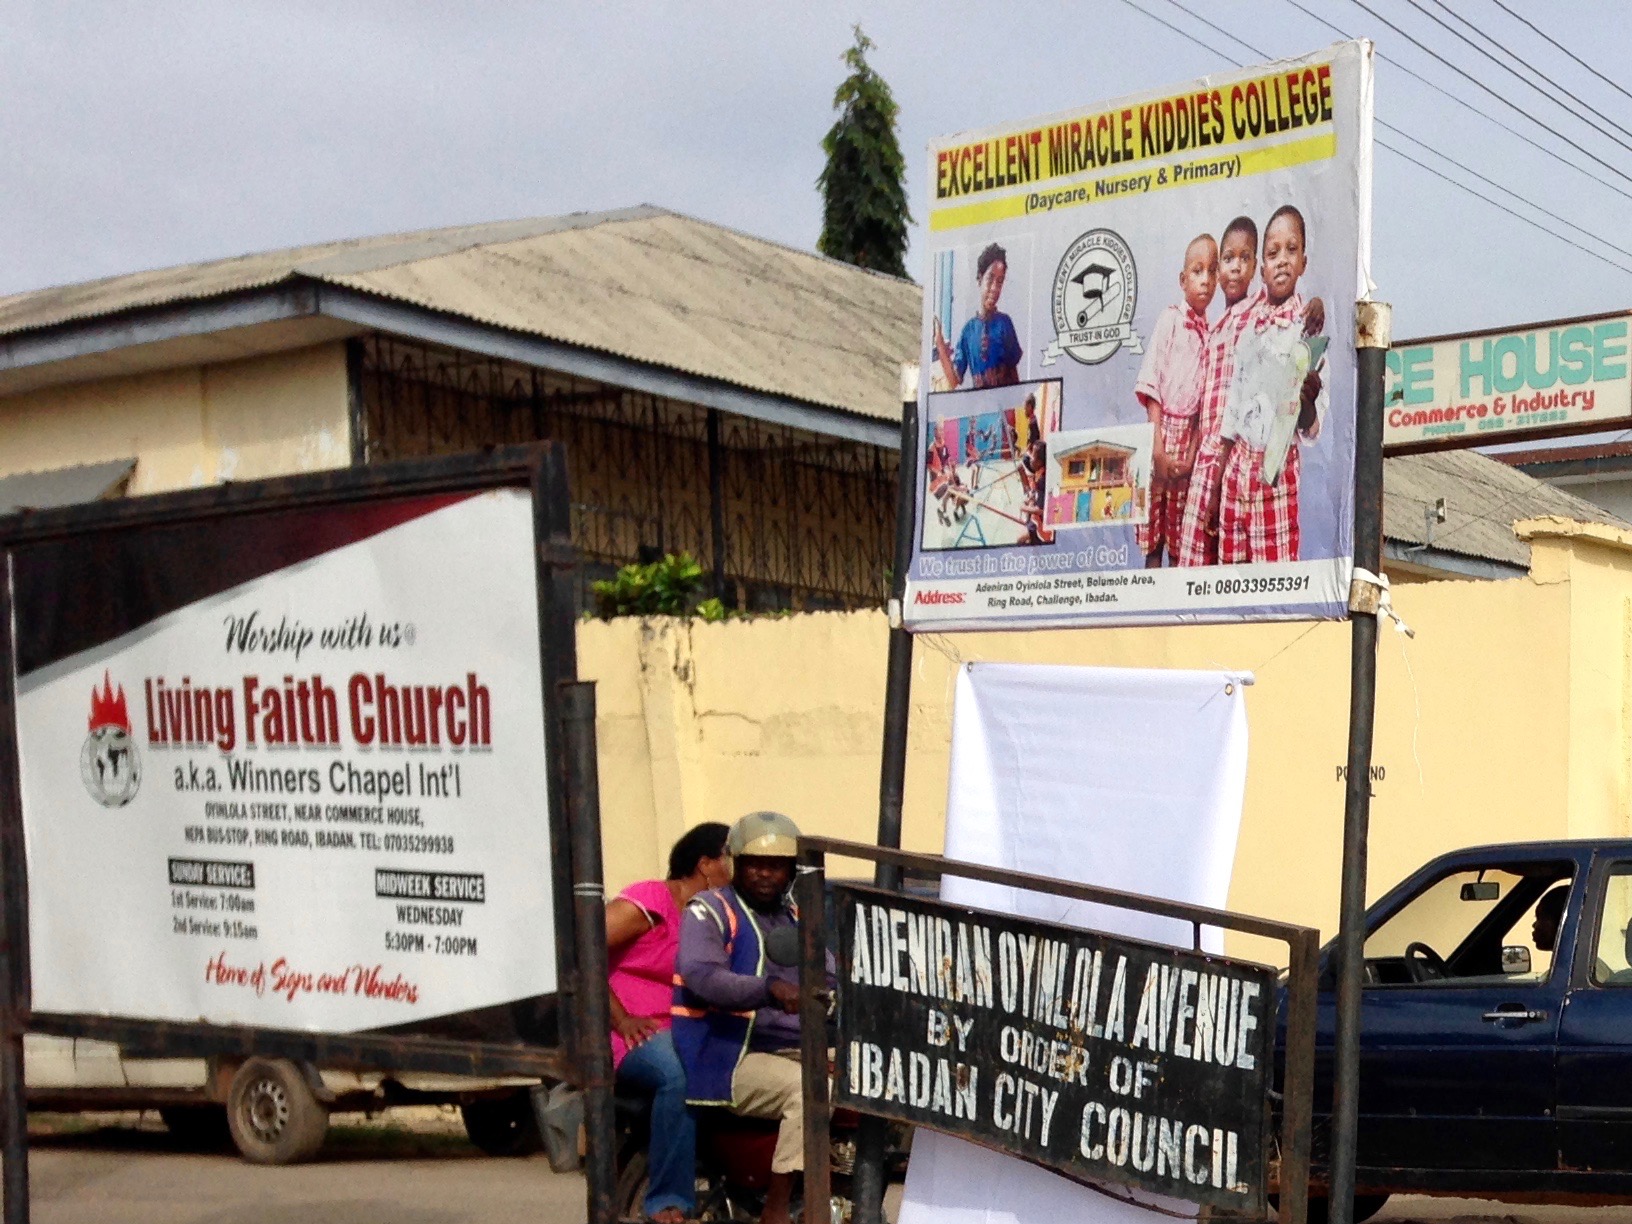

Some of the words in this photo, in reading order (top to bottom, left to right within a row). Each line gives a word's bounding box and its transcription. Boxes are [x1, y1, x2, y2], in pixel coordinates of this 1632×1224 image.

[936, 129, 1042, 199] EXCELLENT
[1048, 109, 1134, 178] MIRACLE
[1140, 88, 1225, 158] KIDDIES
[1231, 64, 1333, 140] COLLEGE
[1024, 187, 1090, 215] (Daycare,
[1094, 168, 1152, 197] Nursery
[1157, 168, 1168, 185] &
[1173, 154, 1242, 181] Primary)
[1070, 331, 1093, 343] TRUST
[1095, 331, 1102, 340] IN
[1104, 328, 1120, 338] GOD
[1459, 321, 1628, 399] HOUSE
[1388, 402, 1488, 429] Commerce
[1493, 397, 1507, 416] &
[920, 556, 943, 576] We
[946, 555, 980, 575] trust
[984, 554, 997, 573] in
[1000, 553, 1025, 573] the
[1027, 552, 1074, 574] power
[1076, 547, 1093, 568] of
[1096, 545, 1128, 566] God
[914, 590, 966, 605] Address:
[976, 582, 1014, 593] Adeniran
[1054, 578, 1084, 590] Street,
[1131, 575, 1155, 586] Area,
[1186, 580, 1212, 596] Tel:
[1215, 575, 1310, 595] 08033955391
[988, 597, 1007, 609] Ring
[1009, 596, 1034, 607] Road,
[224, 610, 312, 661] Worship
[321, 611, 373, 648] with
[145, 676, 235, 753] Living
[243, 673, 340, 748] Faith
[348, 672, 491, 748] Church
[174, 760, 221, 791] a.k.a.
[226, 759, 320, 793] Winners
[329, 761, 411, 802] Chapel
[420, 762, 460, 798] Int'l
[1371, 766, 1385, 781] NO
[250, 802, 292, 823] STREET,
[294, 804, 322, 821] NEAR
[325, 805, 383, 824] COMMERCE
[387, 808, 424, 828] HOUSE,
[255, 829, 278, 846] RING
[281, 830, 312, 849] ROAD,
[360, 832, 381, 850] TEL:
[383, 833, 454, 854] 07035299938
[377, 873, 430, 896] MIDWEEK
[434, 876, 483, 900] SERVICE
[396, 904, 463, 925] WEDNESDAY
[385, 931, 424, 952] 5:30PM
[435, 935, 477, 955] 7:00PM
[206, 951, 247, 985] Home
[251, 961, 265, 997] of
[271, 957, 313, 1002] Signs
[317, 967, 349, 995] and
[352, 964, 418, 1004] Wonders
[852, 903, 993, 1009] ADENIRAN
[999, 931, 1127, 1043] OYINLOLA
[1133, 962, 1261, 1071] AVENUE
[927, 1008, 975, 1052] BY
[1000, 1026, 1090, 1086] ORDER
[1109, 1056, 1159, 1099] OF
[849, 1041, 978, 1121] IBADAN
[993, 1073, 1059, 1147] CITY
[1080, 1101, 1248, 1194] COUNCIL
